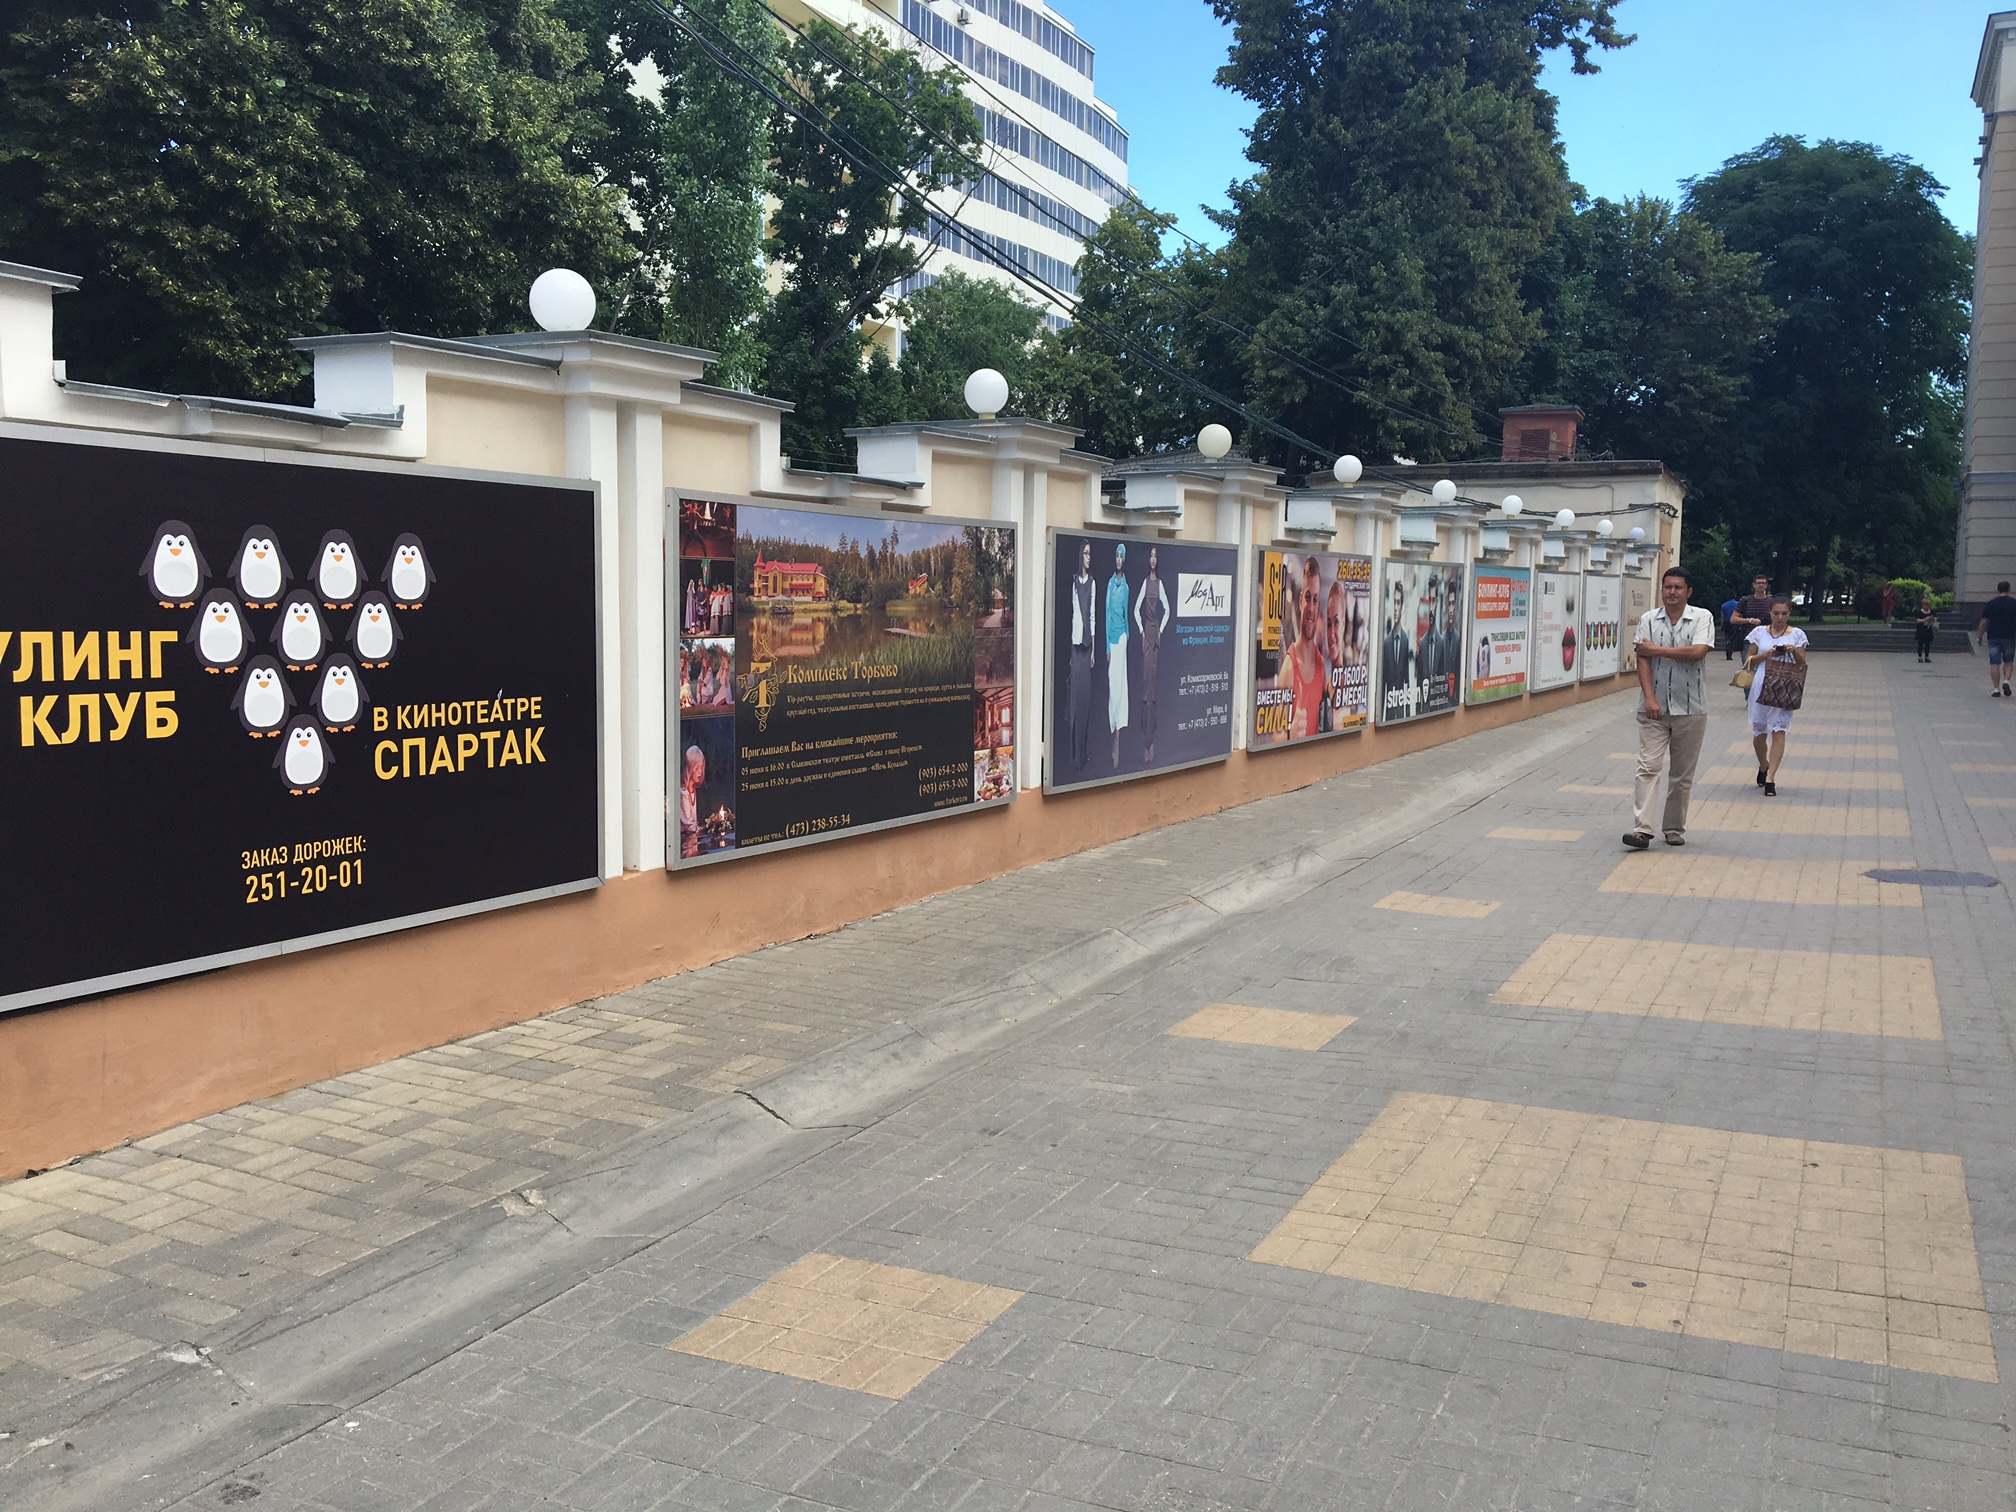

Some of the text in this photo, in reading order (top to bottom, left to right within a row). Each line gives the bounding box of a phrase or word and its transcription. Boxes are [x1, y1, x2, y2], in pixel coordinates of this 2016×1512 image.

[1338, 561, 1370, 580] 260-35-35
[787, 661, 899, 684] Комплекс Торбово
[1332, 667, 1343, 687] ОТ
[1344, 666, 1360, 685] 1600
[1257, 690, 1282, 705] ВМЕСТЕ
[1282, 689, 1293, 703] МЫ
[1335, 685, 1367, 707] В МЕСЯЦ
[1388, 683, 1420, 708] strellsn
[19, 690, 179, 747] КЛУБ
[373, 696, 543, 732] В КИНОТЕАТРЕ
[1257, 704, 1293, 735] СИЛА!
[374, 726, 546, 781] СПАРТАК
[741, 745, 790, 760] Приглашаем
[791, 740, 803, 752] Вас
[815, 737, 854, 748] ближайшие
[918, 766, 937, 781] (903)
[919, 781, 937, 797] (903)
[785, 820, 810, 839] (473)
[812, 813, 851, 831] 238-55-34
[241, 836, 367, 870] ЗАКАЗ ДОРОЖЕК:
[245, 859, 364, 904] 251-20-01
